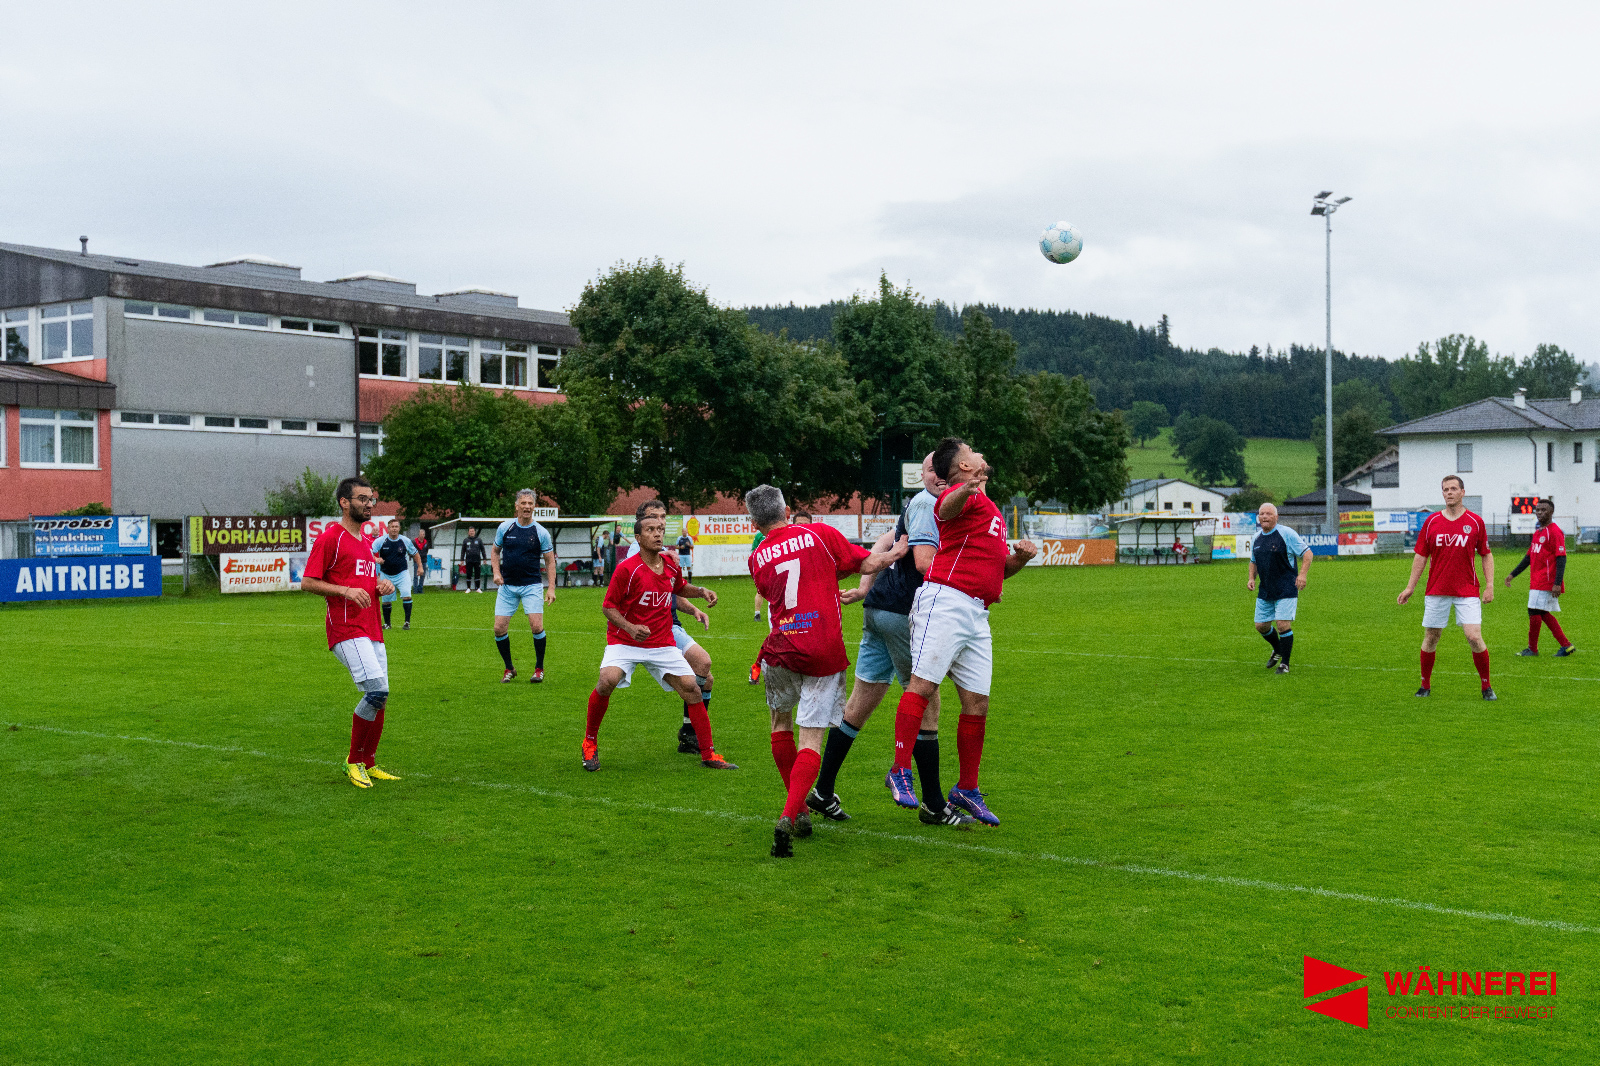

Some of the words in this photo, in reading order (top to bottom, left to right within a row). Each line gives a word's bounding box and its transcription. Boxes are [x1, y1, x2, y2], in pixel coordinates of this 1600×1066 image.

[533, 509, 556, 517] HEIM
[35, 517, 114, 532] nprobst
[212, 517, 296, 529] bäckerei
[704, 523, 758, 534] KRIECHB
[35, 533, 104, 542] sswalchen
[205, 529, 303, 545] VORHAUER
[1435, 533, 1469, 548] EVN
[756, 533, 815, 569] AUSTRIA
[15, 563, 145, 594] ANTRIEBE
[229, 576, 282, 585] FRIEDBURG
[774, 557, 801, 611] 7
